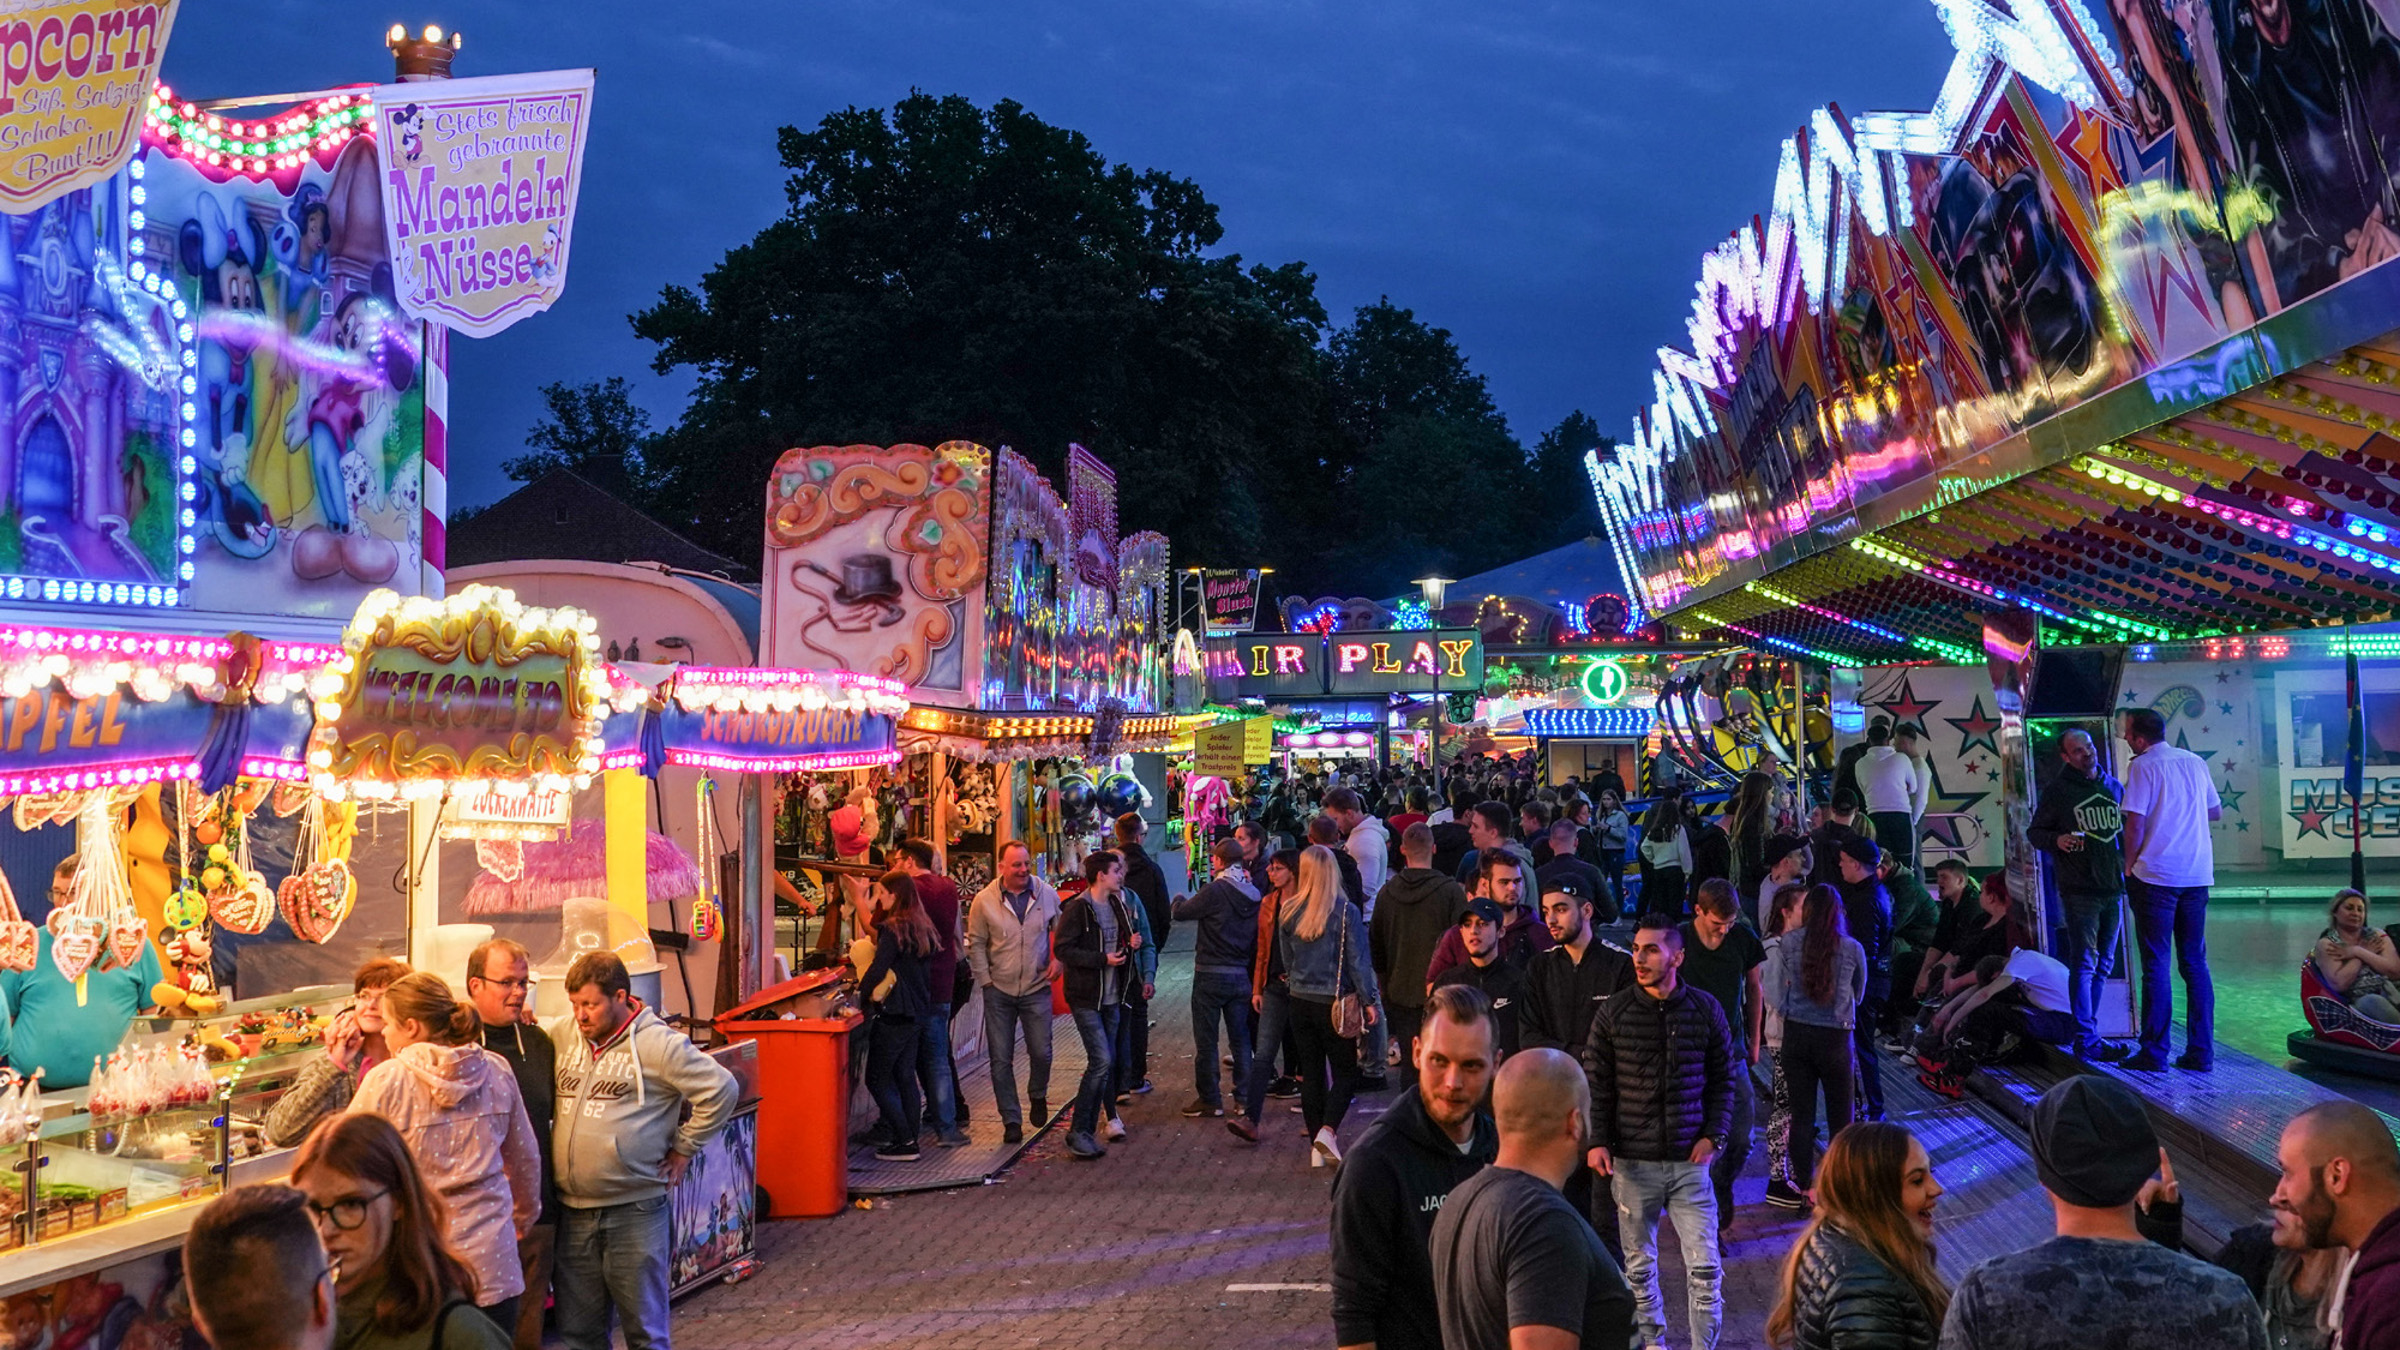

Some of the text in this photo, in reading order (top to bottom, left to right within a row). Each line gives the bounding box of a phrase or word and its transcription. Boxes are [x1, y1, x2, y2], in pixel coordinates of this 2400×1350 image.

[435, 97, 573, 142] Stets frisch
[13, 130, 114, 182] Bunt!!!
[449, 129, 565, 173] gebrannte
[389, 157, 566, 239] Mandeln
[420, 237, 532, 301] Nüsse
[1206, 578, 1251, 599] Monster
[1216, 594, 1254, 614] Slush
[1338, 640, 1474, 677] PLAY
[363, 667, 563, 733] WELCOME TO
[0, 688, 126, 754] PFEL
[1210, 733, 1231, 741] Jeder
[1201, 763, 1237, 771] Trostpreis
[1207, 743, 1233, 752] Spieler
[1221, 753, 1242, 761] einen
